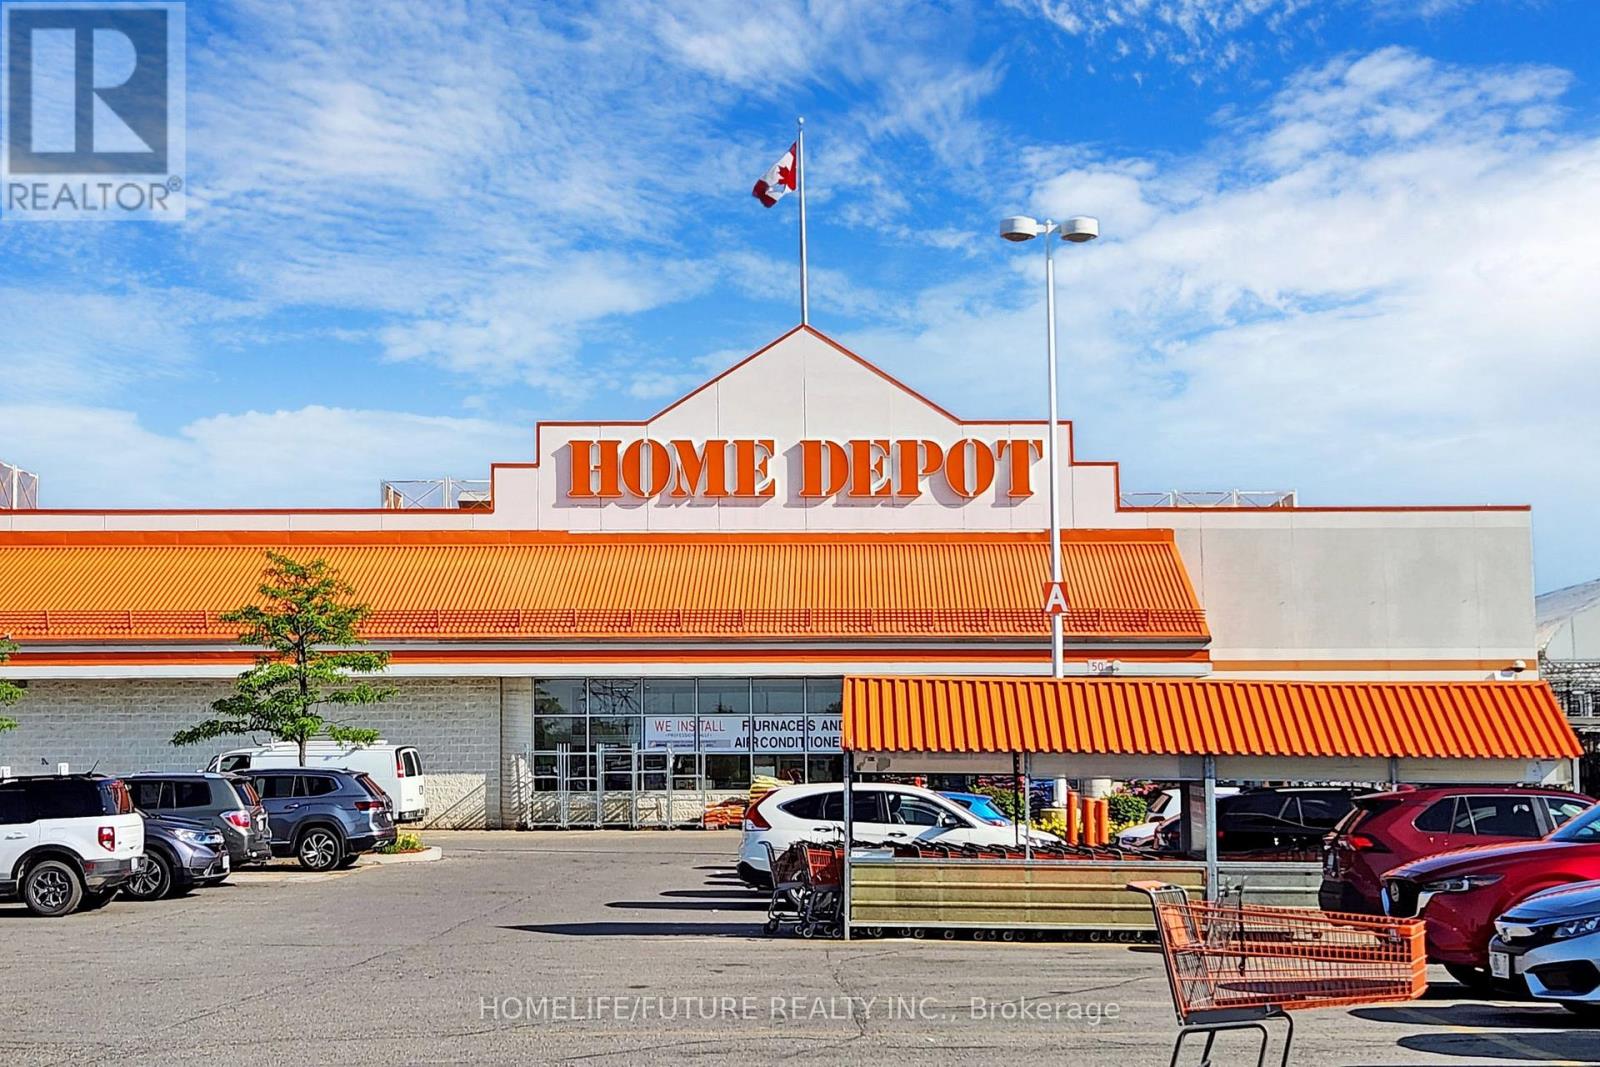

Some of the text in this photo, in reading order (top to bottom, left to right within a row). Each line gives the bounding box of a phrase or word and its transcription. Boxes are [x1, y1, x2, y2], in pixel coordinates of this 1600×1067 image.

[566, 439, 1044, 498] HOME DEPOT
[1045, 583, 1070, 613] A
[654, 720, 726, 732] WE INSTALL
[742, 720, 816, 731] FURNACES
[734, 737, 843, 748] AIRCONDITIONE
